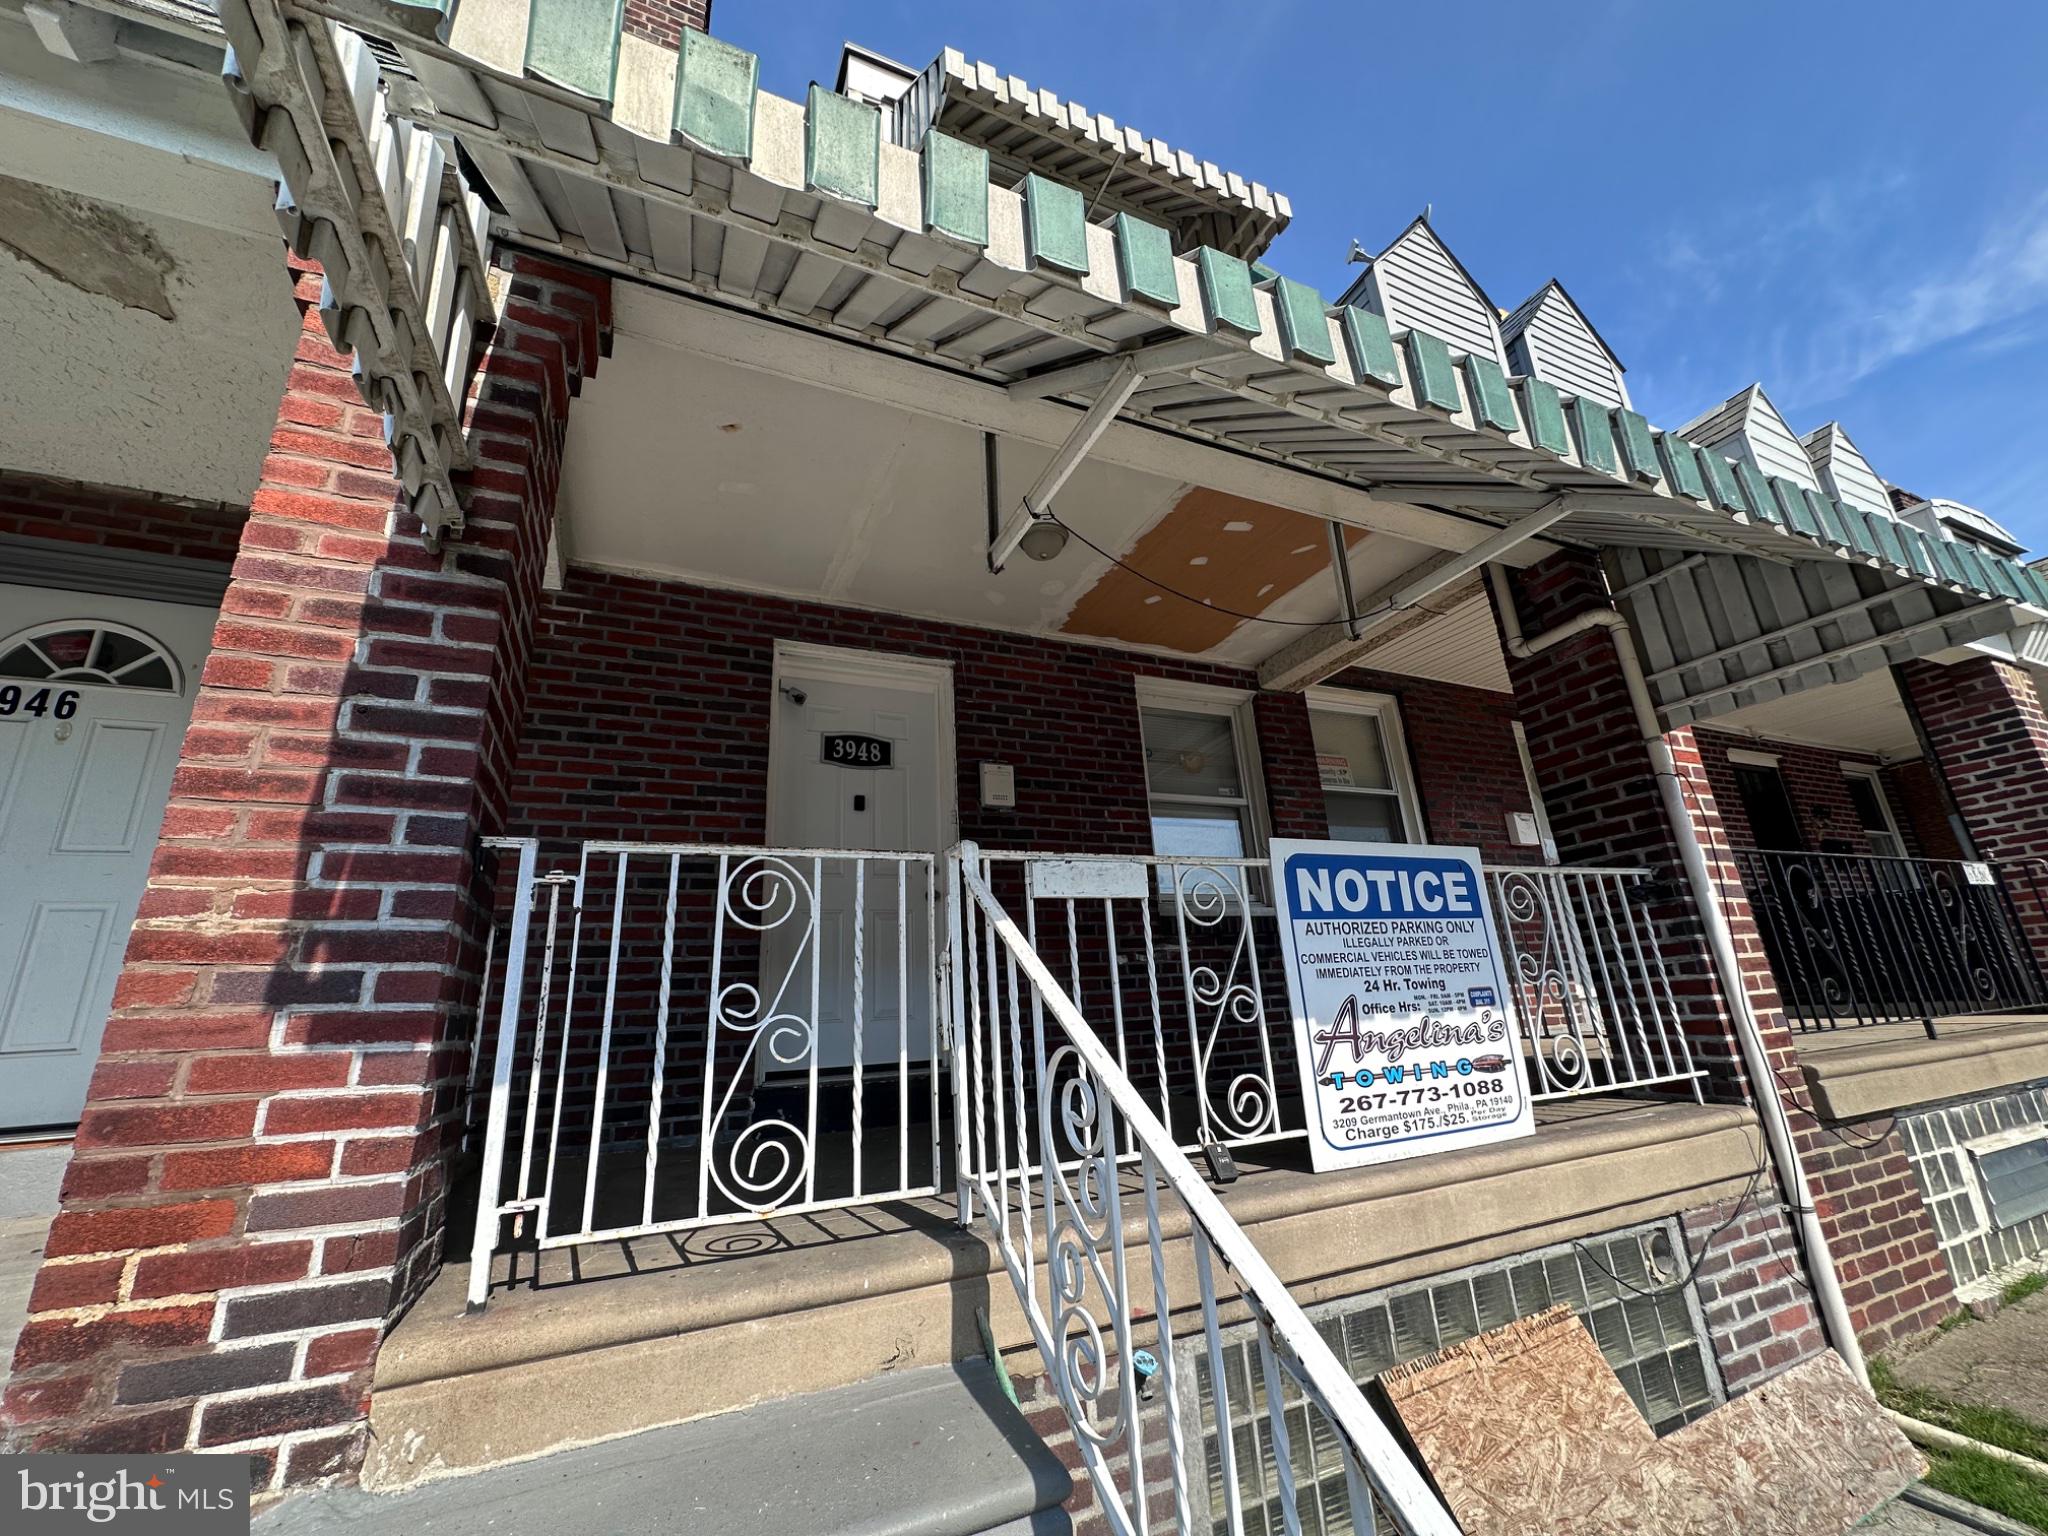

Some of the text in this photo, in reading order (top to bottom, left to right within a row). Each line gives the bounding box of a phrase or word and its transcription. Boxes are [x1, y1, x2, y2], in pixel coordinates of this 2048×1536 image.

[0, 685, 81, 720] 946
[833, 738, 881, 763] 3948
[1296, 867, 1473, 913] NOTICE
[1305, 920, 1474, 936] AUTHORIZED PARKING ONLY
[1342, 936, 1449, 948] ILLEGALLY PARKED OR
[1300, 948, 1489, 965] COMMERCIAL VEHICLES WILL BE TOWED
[1316, 962, 1480, 979] IMMEDIATELY FROM THE PROPERTY
[1363, 977, 1446, 993] 24 Hr. Towing
[1362, 1001, 1421, 1015] Office Hrs:
[1313, 993, 1506, 1076] Angelina's
[1330, 1058, 1474, 1090] TOWING
[1339, 1078, 1504, 1114] 267-773-1088
[1332, 1117, 1358, 1129] 3209
[1360, 1109, 1422, 1126] Germantown
[1475, 1099, 1488, 1108] PA
[1489, 1095, 1513, 1106] 19140
[1470, 1108, 1486, 1116] Per
[1472, 1112, 1507, 1122] Storage
[1345, 1125, 1400, 1141] Charge
